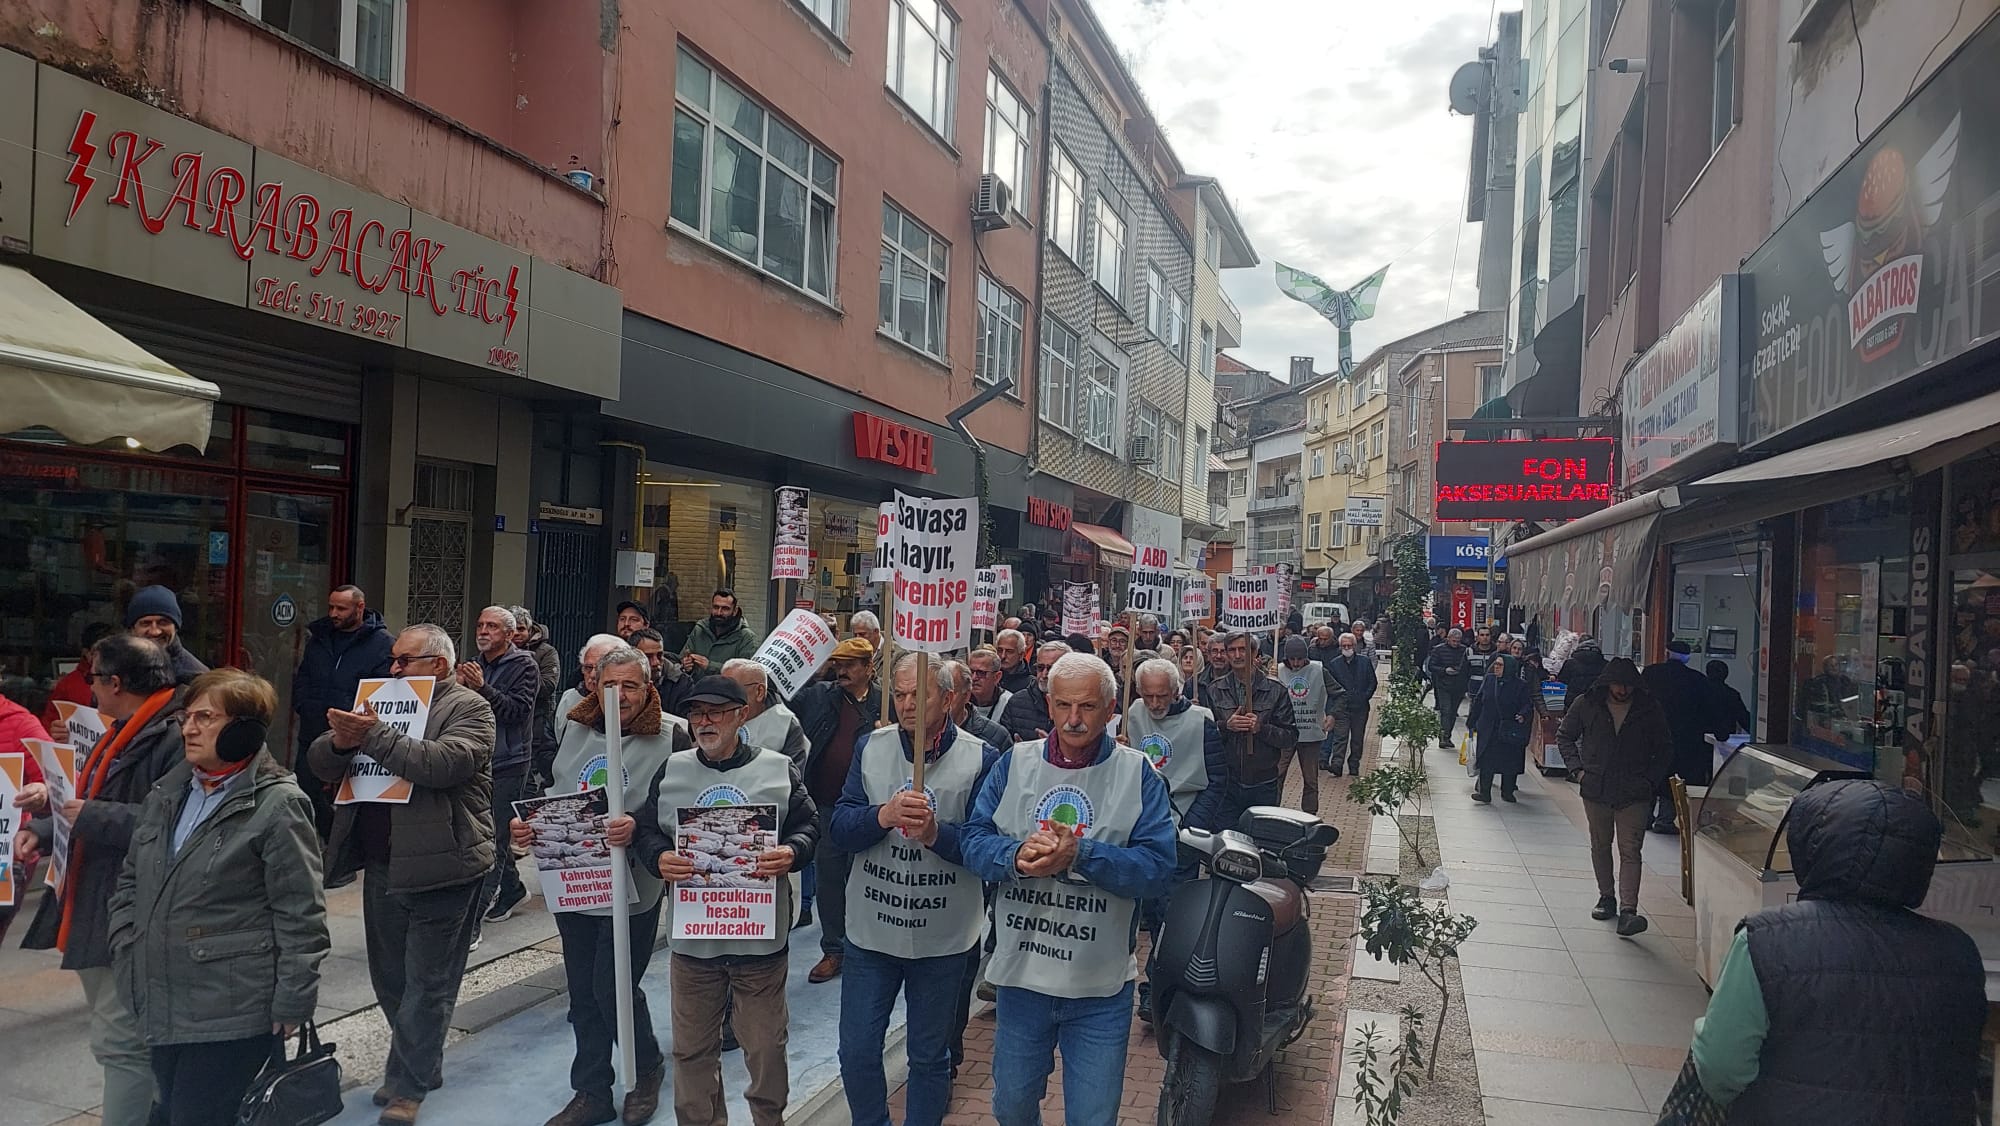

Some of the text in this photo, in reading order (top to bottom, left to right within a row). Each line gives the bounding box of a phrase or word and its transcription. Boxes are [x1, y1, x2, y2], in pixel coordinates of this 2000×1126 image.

[107, 131, 447, 317] KARABACAK
[256, 277, 403, 341] Tel: 511 3927
[1852, 261, 1919, 335] ALBATROS
[1761, 295, 1791, 337] SOKAK
[854, 412, 937, 475] VESTEL
[1523, 457, 1587, 481] FON
[898, 496, 968, 537] Savaşa
[1049, 502, 1073, 531] SHOP
[900, 535, 955, 574] hayır,
[1141, 546, 1168, 569] ABD
[894, 568, 968, 609] direnişe
[977, 570, 996, 583] ABD
[1228, 575, 1269, 594] Direnen
[1228, 594, 1267, 611] halklar
[895, 611, 949, 642] selam
[1907, 526, 1931, 742] ALBATROS
[764, 646, 796, 675] halklar
[771, 638, 805, 669] direnen
[371, 700, 419, 716] ATO'DAN
[891, 844, 922, 862] TÜM
[863, 859, 957, 887] EMEKLİLERİN
[679, 888, 773, 904] Bu çocukların
[864, 885, 947, 910] SENDİKASI
[706, 904, 750, 919] hesabı
[877, 911, 927, 929] FINDIKLI
[684, 921, 766, 936] sorulacaktır
[1005, 913, 1097, 942] SENDİKASI
[1018, 941, 1073, 962] FINDIKLI
